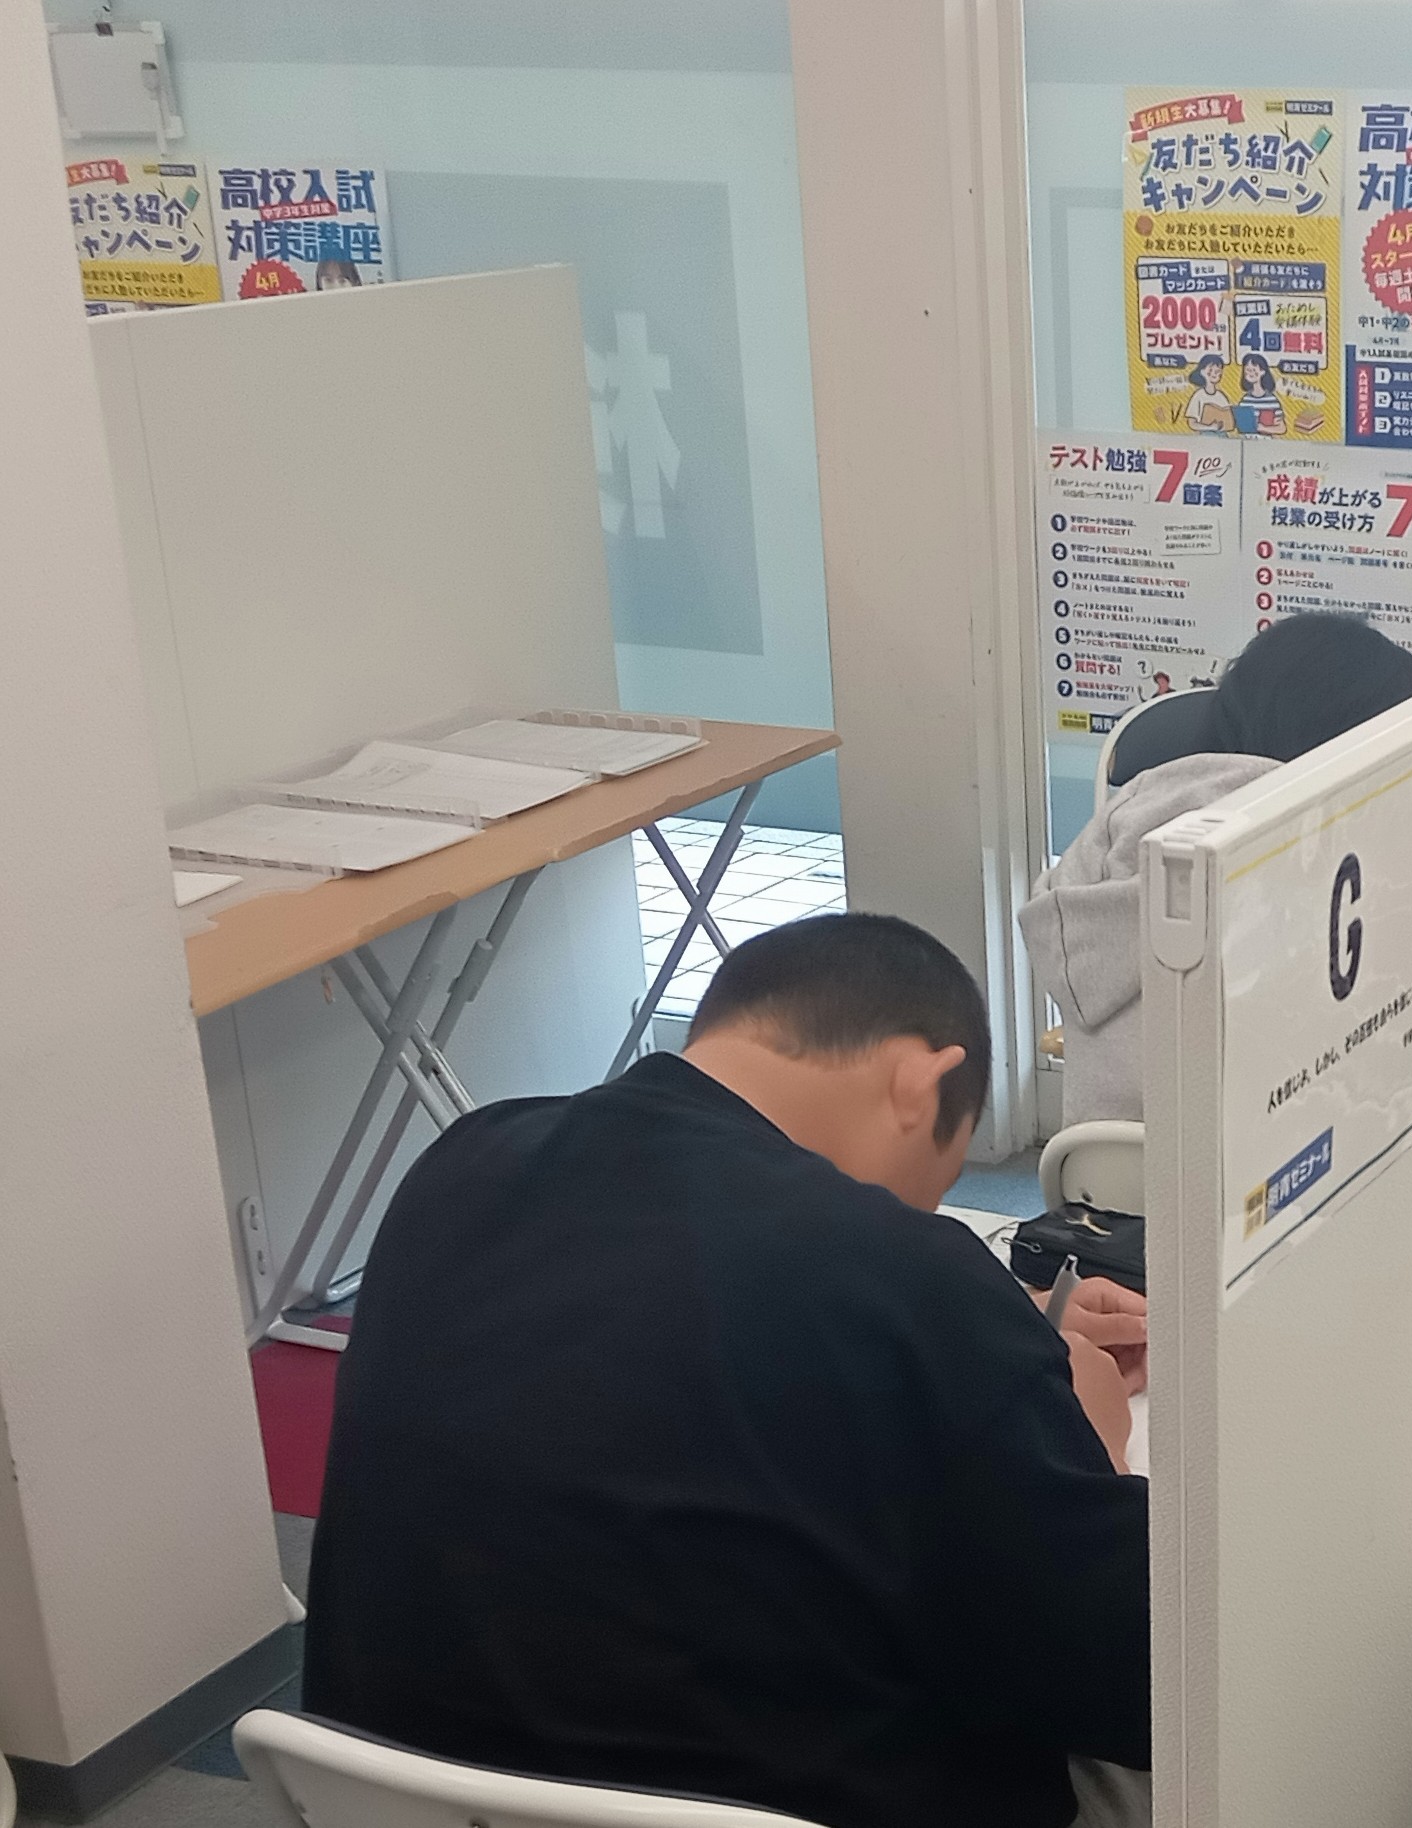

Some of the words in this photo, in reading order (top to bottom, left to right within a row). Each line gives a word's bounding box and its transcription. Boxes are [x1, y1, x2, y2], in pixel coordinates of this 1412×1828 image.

[1151, 132, 1315, 176] 友だち紹介
[218, 168, 375, 213] 高校入試
[1141, 175, 1324, 215] キャンペーン
[78, 228, 201, 262] ャンペーン
[226, 219, 382, 264] 対策講座
[254, 271, 281, 290] 4月
[1164, 277, 1226, 291] マックカード
[1146, 333, 1222, 351] プレゼント!
[1050, 445, 1147, 474] テスト勉強
[1153, 450, 1189, 503] 7
[1266, 474, 1382, 508] 成績が上がる
[1271, 506, 1375, 533] 授業の受け方
[1329, 852, 1363, 1002] G
